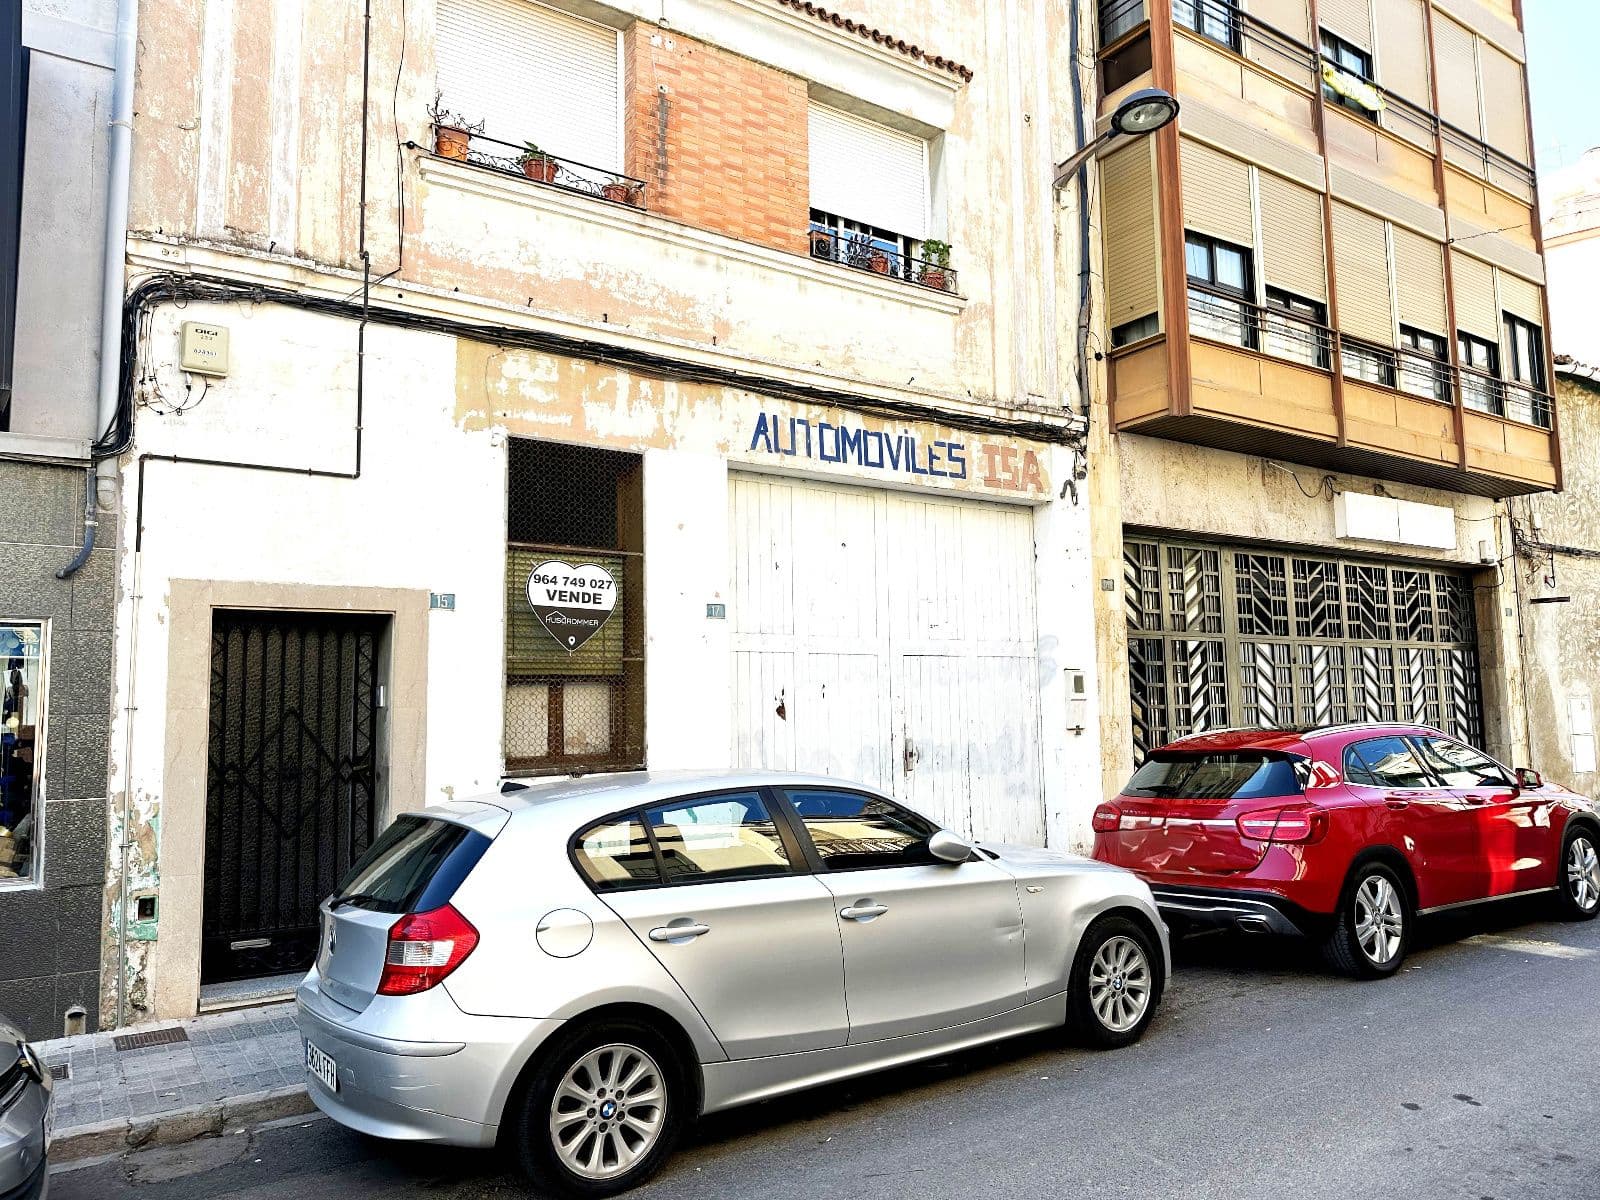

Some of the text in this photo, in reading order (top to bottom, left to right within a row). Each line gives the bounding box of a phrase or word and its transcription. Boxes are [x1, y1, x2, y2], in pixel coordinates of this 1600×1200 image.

[982, 444, 1043, 493] ISA
[533, 574, 613, 590] 964 749 027
[437, 595, 448, 608] 15
[546, 588, 602, 604] VENDE
[711, 605, 720, 617] 17
